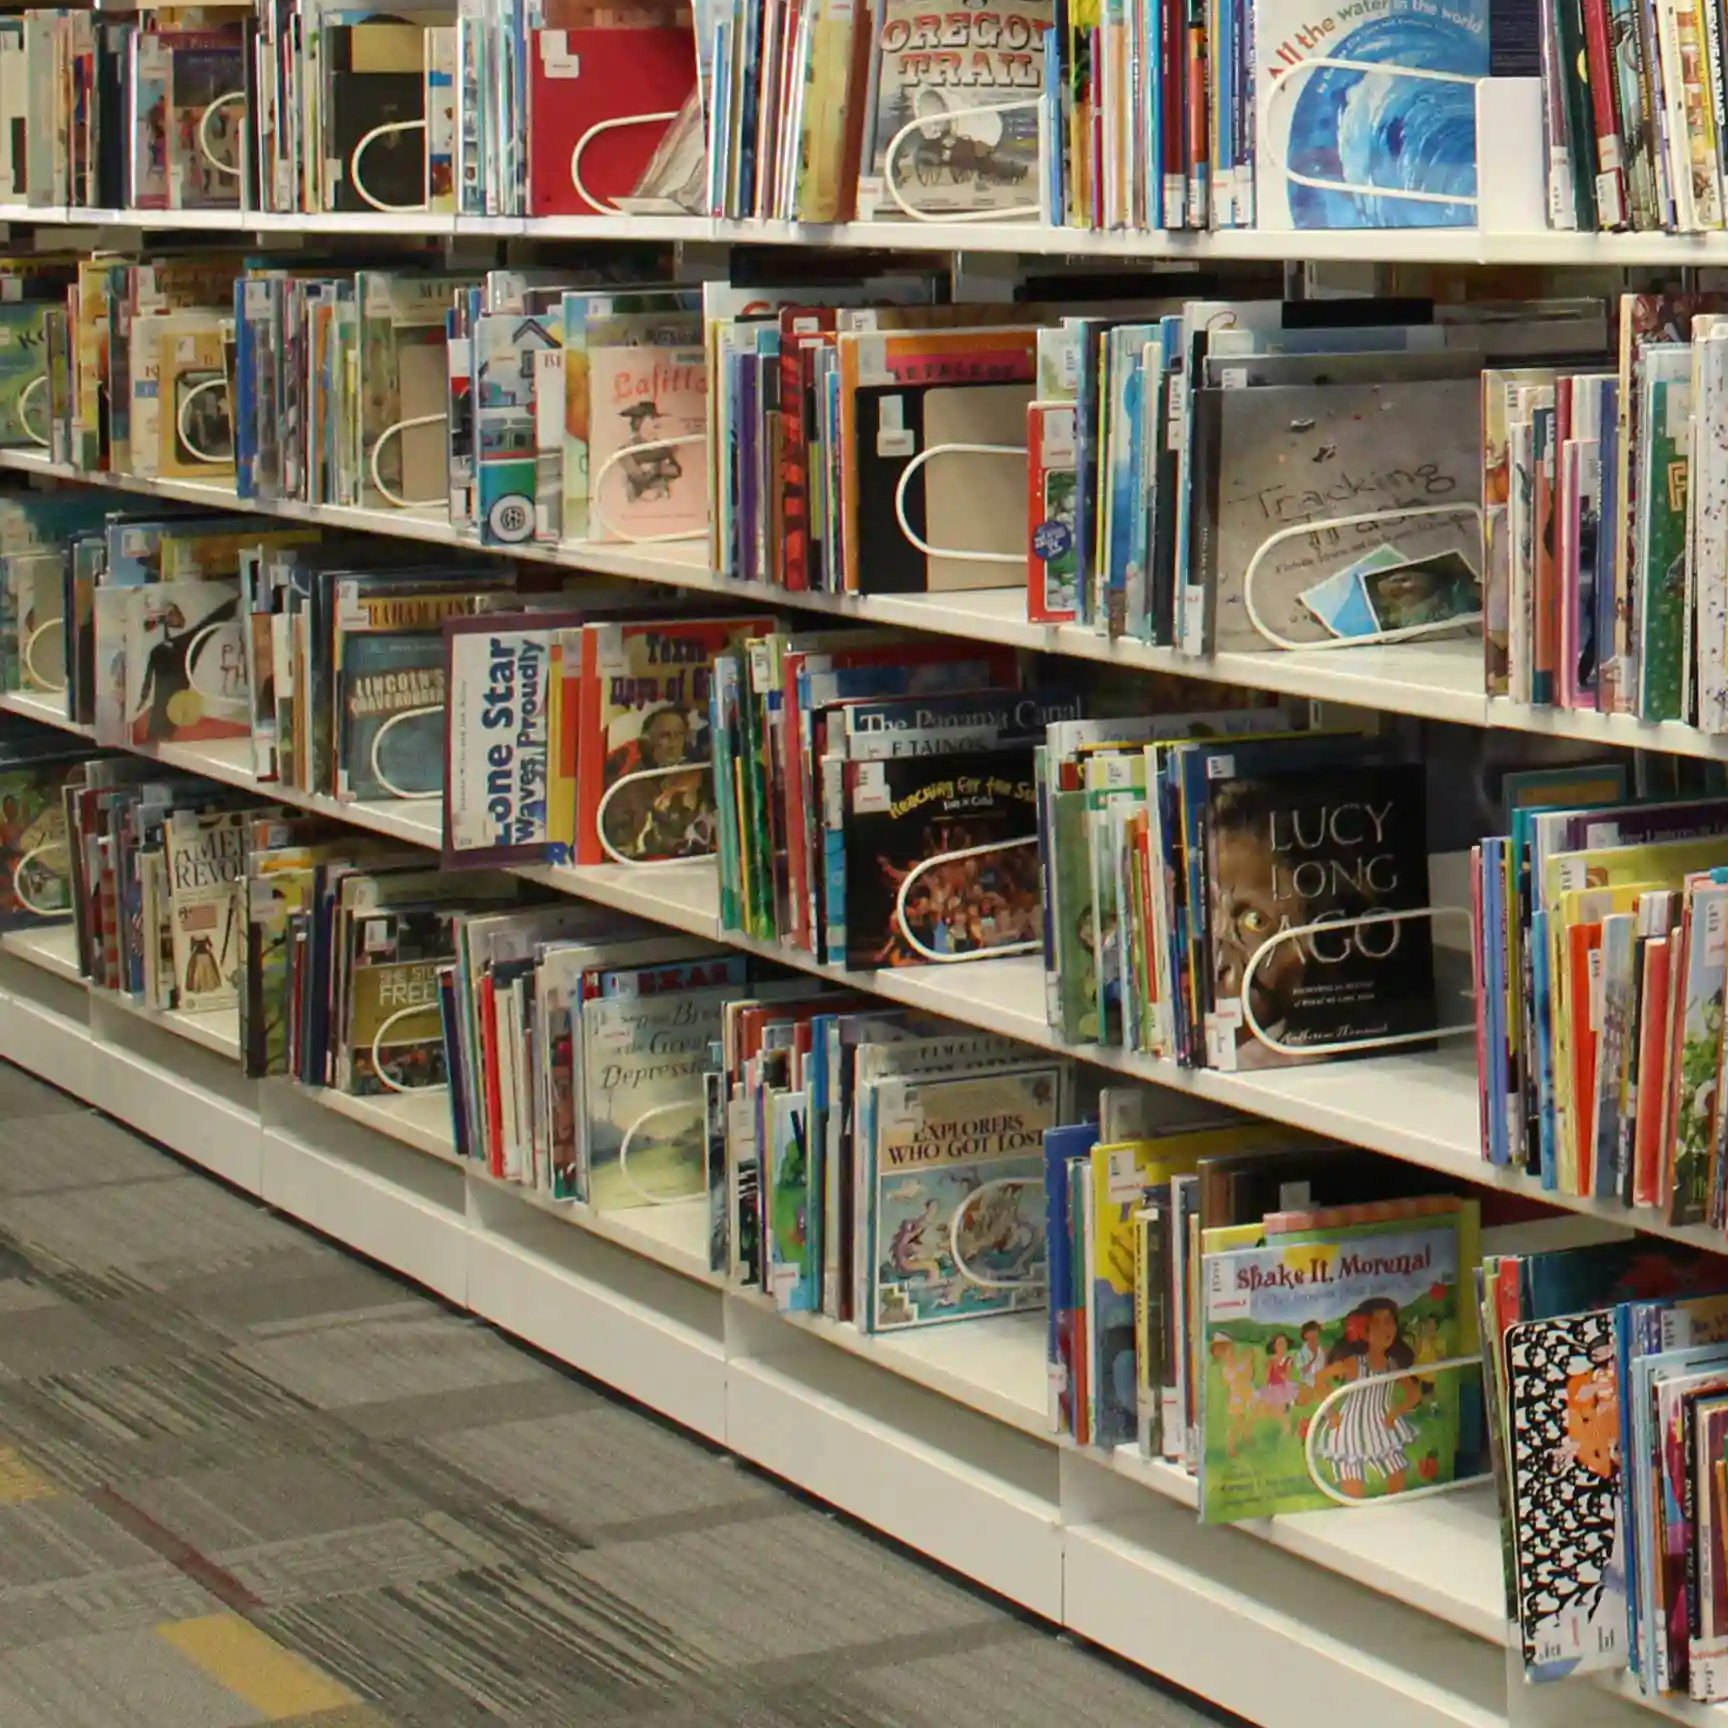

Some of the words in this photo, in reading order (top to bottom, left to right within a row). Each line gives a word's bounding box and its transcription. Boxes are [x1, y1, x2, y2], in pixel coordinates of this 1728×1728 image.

[1294, 16, 1335, 50] the
[1441, 7, 1484, 34] world
[898, 50, 1041, 88] TRAIL
[482, 638, 516, 729] Star
[517, 639, 546, 748] Proudly
[860, 713, 907, 733] The
[915, 708, 1008, 731] Panama
[1016, 696, 1082, 728] Canal
[488, 744, 515, 846] Lone
[1270, 801, 1393, 853] LUCY
[1271, 854, 1398, 902] LONG
[1265, 906, 1400, 969] AGO
[888, 1142, 940, 1165] WHO
[947, 1136, 990, 1158] GOT
[913, 1113, 1025, 1143] EXPLORERS
[1236, 1262, 1304, 1291] Shake
[1339, 1243, 1432, 1279] Morena!
